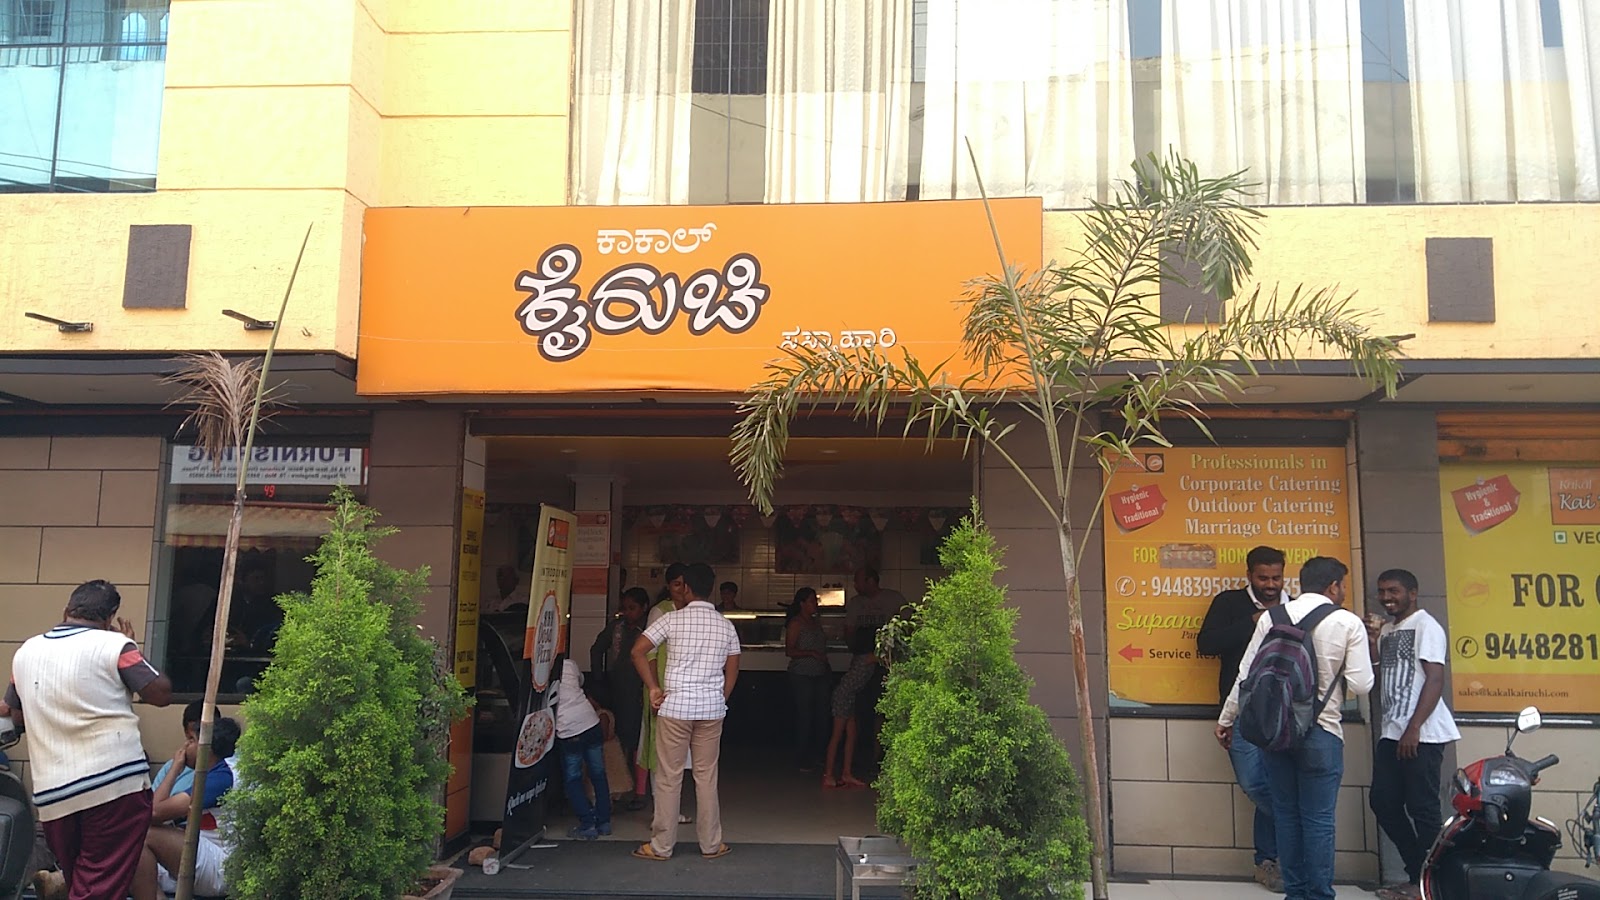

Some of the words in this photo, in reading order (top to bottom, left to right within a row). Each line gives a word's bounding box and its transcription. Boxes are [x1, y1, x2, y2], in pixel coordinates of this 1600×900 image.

[597, 222, 717, 254] ಕಾಕಾಲ್
[515, 244, 770, 362] ಕೈರುಚಿ
[1191, 453, 1305, 470] Professionals
[1311, 454, 1327, 470] in
[1179, 475, 1264, 494] Corporate
[1269, 475, 1341, 494] Catering
[1465, 483, 1499, 501] Hygienic
[1121, 490, 1150, 504] Hygienic
[1135, 501, 1142, 511] &
[1483, 497, 1491, 507] &
[1559, 493, 1596, 511] Kai
[1123, 507, 1159, 524] Traditional
[1187, 497, 1257, 514] Outdoor
[1262, 497, 1335, 516] Catering
[1470, 501, 1512, 524] Traditional
[1185, 518, 1261, 538] Marriage
[1267, 518, 1340, 538] Catering
[1133, 547, 1158, 563] FOR
[1219, 547, 1247, 564] HOM
[1285, 547, 1318, 564] VERY
[1511, 573, 1585, 608] FOR
[1149, 648, 1191, 660] Service
[1485, 632, 1598, 660] 9448281
[1458, 687, 1569, 699] sales@kakalkairuchi.com
